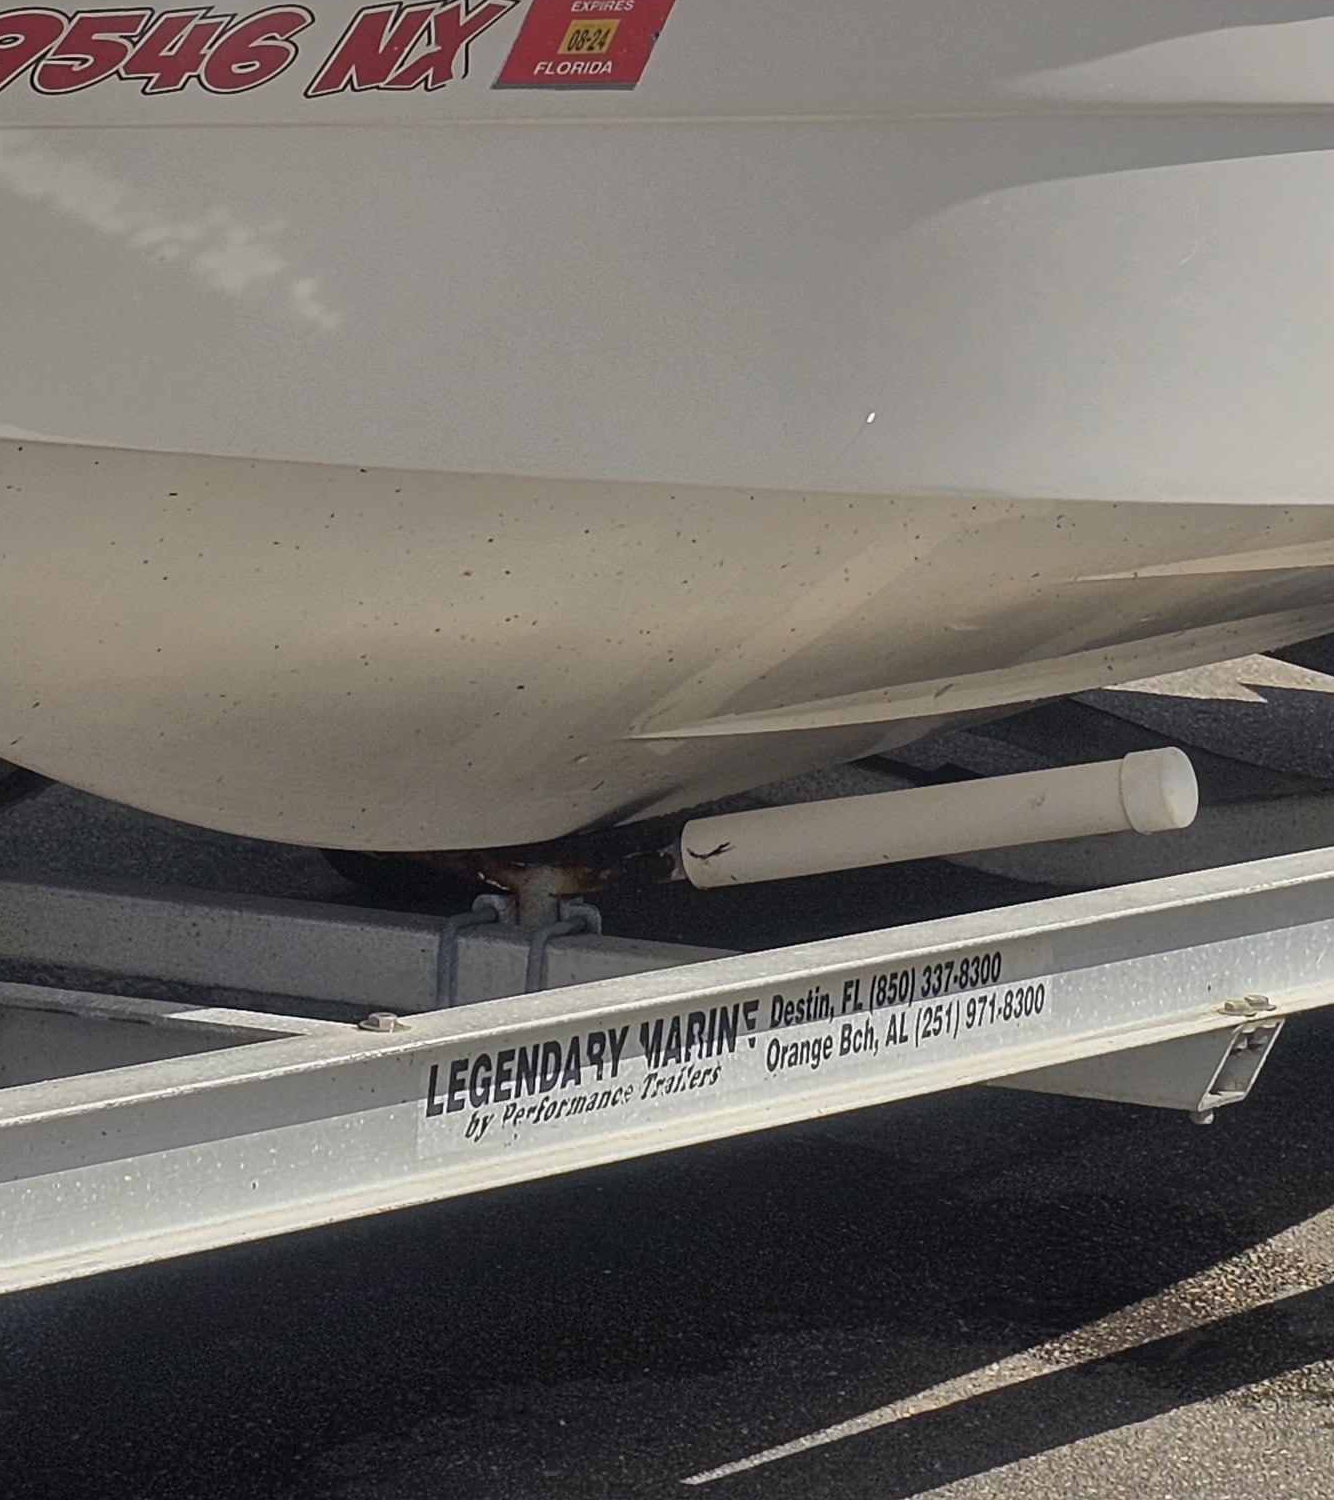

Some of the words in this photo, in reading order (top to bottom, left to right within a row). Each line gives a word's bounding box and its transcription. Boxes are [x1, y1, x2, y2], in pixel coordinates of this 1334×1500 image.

[570, 0, 635, 12] EXPIRES
[533, 60, 613, 75] FLORIDA
[567, 28, 611, 52] 08-24
[769, 986, 835, 1028] Destin,
[841, 978, 864, 1014] FL
[869, 967, 916, 1013] (850)
[920, 951, 1002, 998] 337-8300
[766, 1032, 833, 1072] Orange
[839, 1018, 880, 1056] Bch,
[884, 1011, 909, 1047] AL
[915, 999, 960, 1048] (251)
[965, 983, 1046, 1029] 971-8300
[425, 1025, 630, 1117] LEGENDARY
[464, 1110, 495, 1143] by
[501, 1084, 634, 1130] Performance
